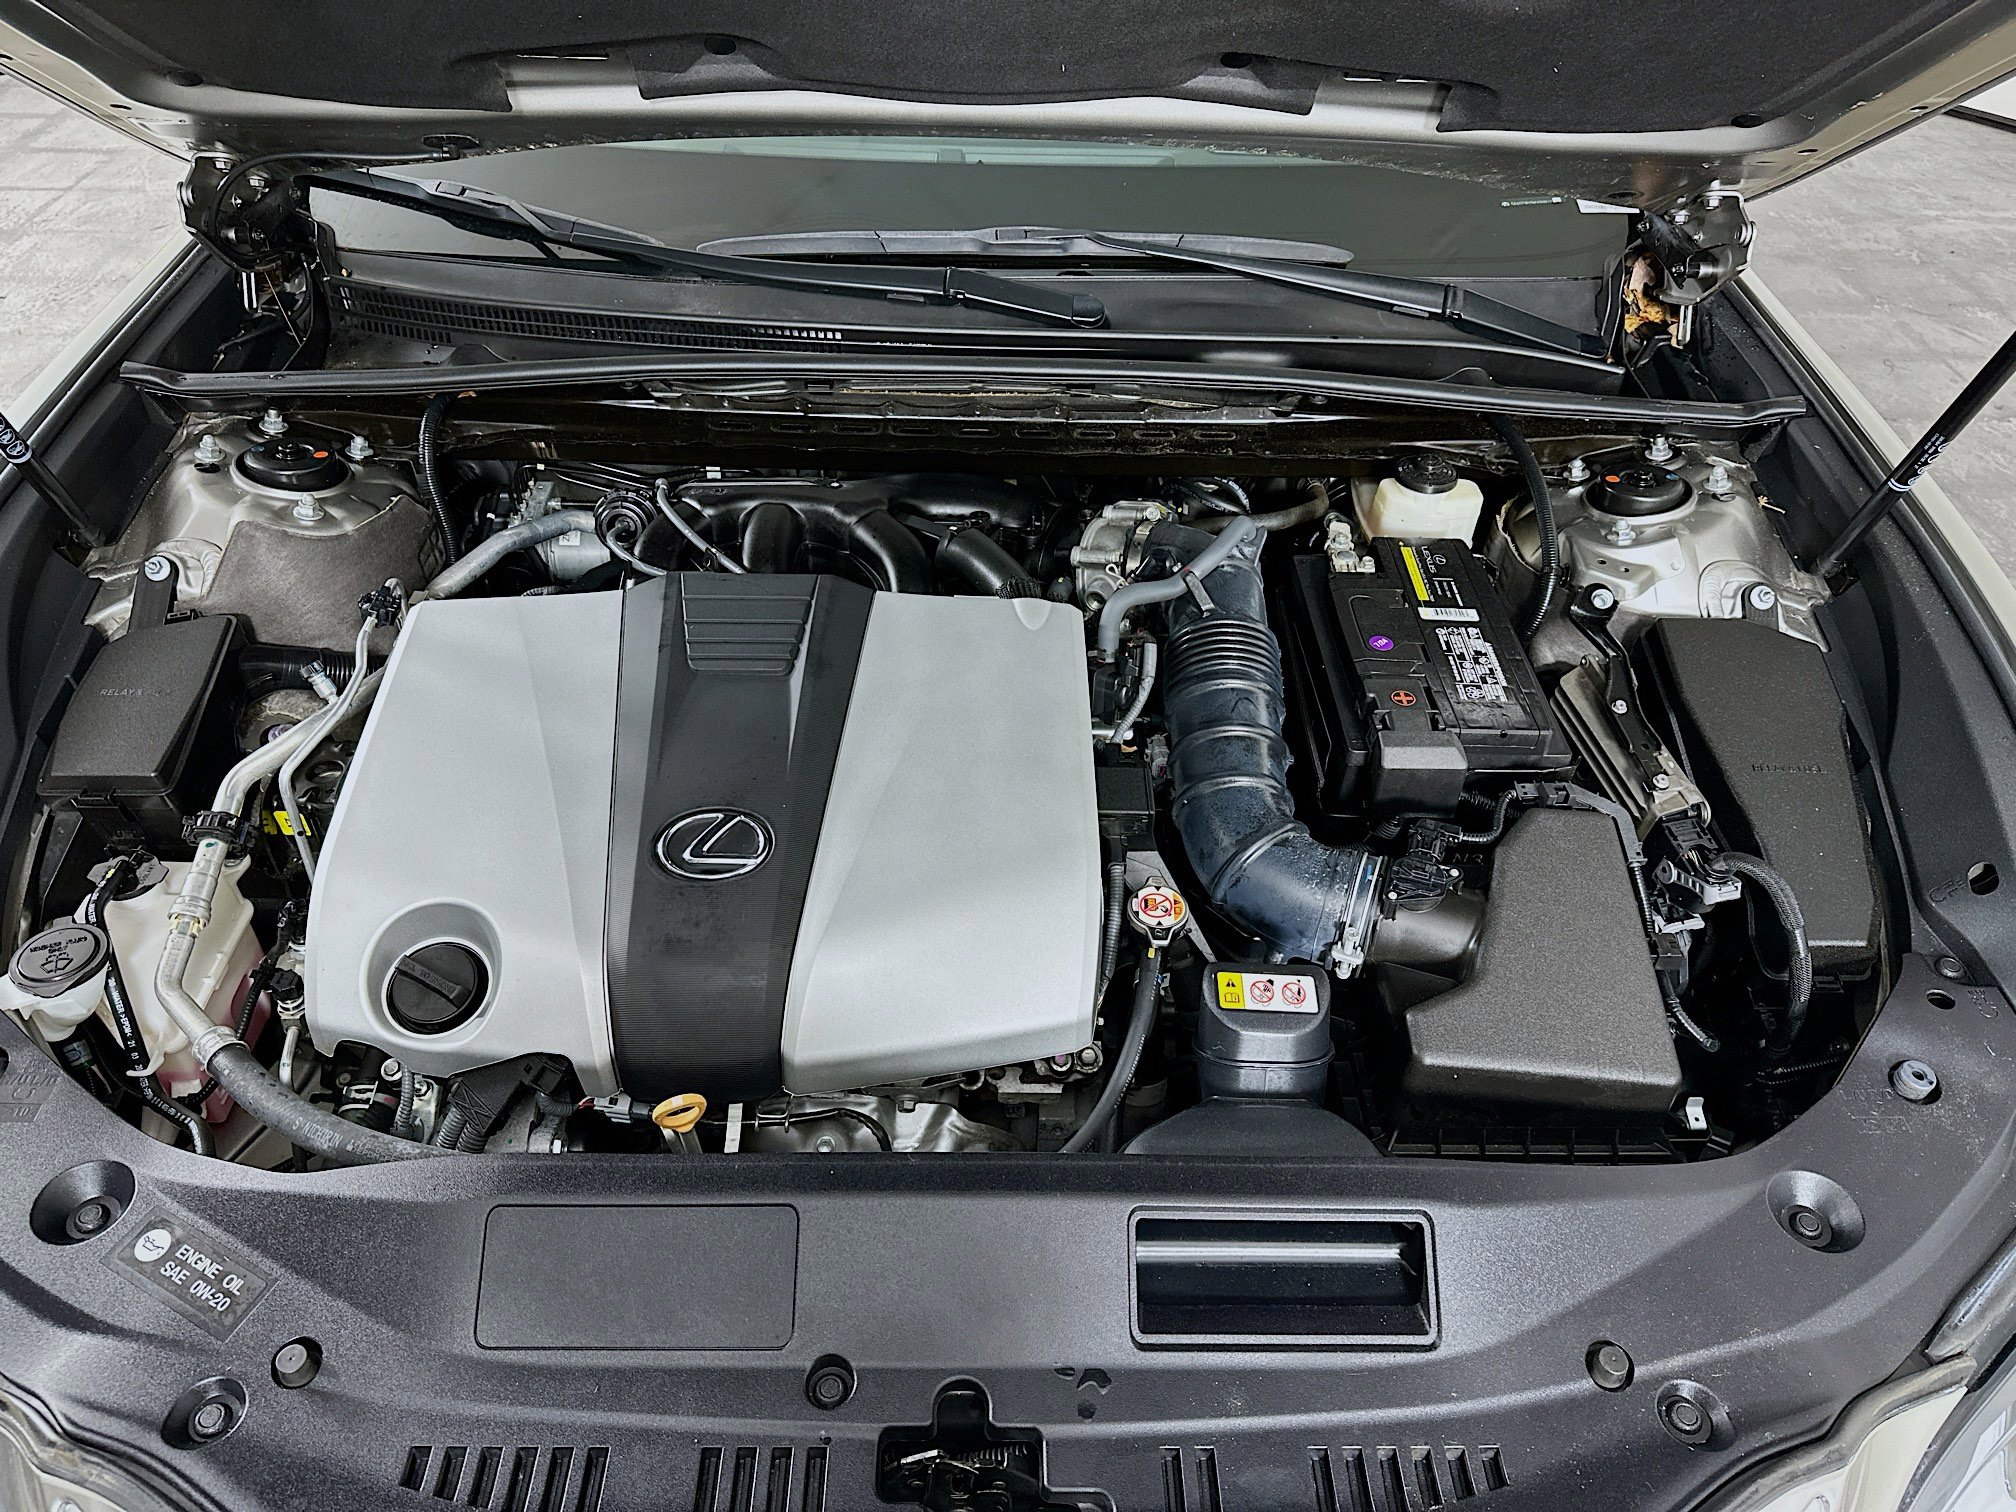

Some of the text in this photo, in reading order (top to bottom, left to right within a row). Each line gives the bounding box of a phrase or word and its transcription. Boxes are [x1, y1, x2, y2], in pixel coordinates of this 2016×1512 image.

[1421, 546, 1437, 573] LEXUS
[100, 687, 135, 696] RELAY
[112, 990, 126, 1014] WATER
[175, 1244, 245, 1296] ENGINE OIL
[160, 1261, 231, 1312] SAE 0W-20
